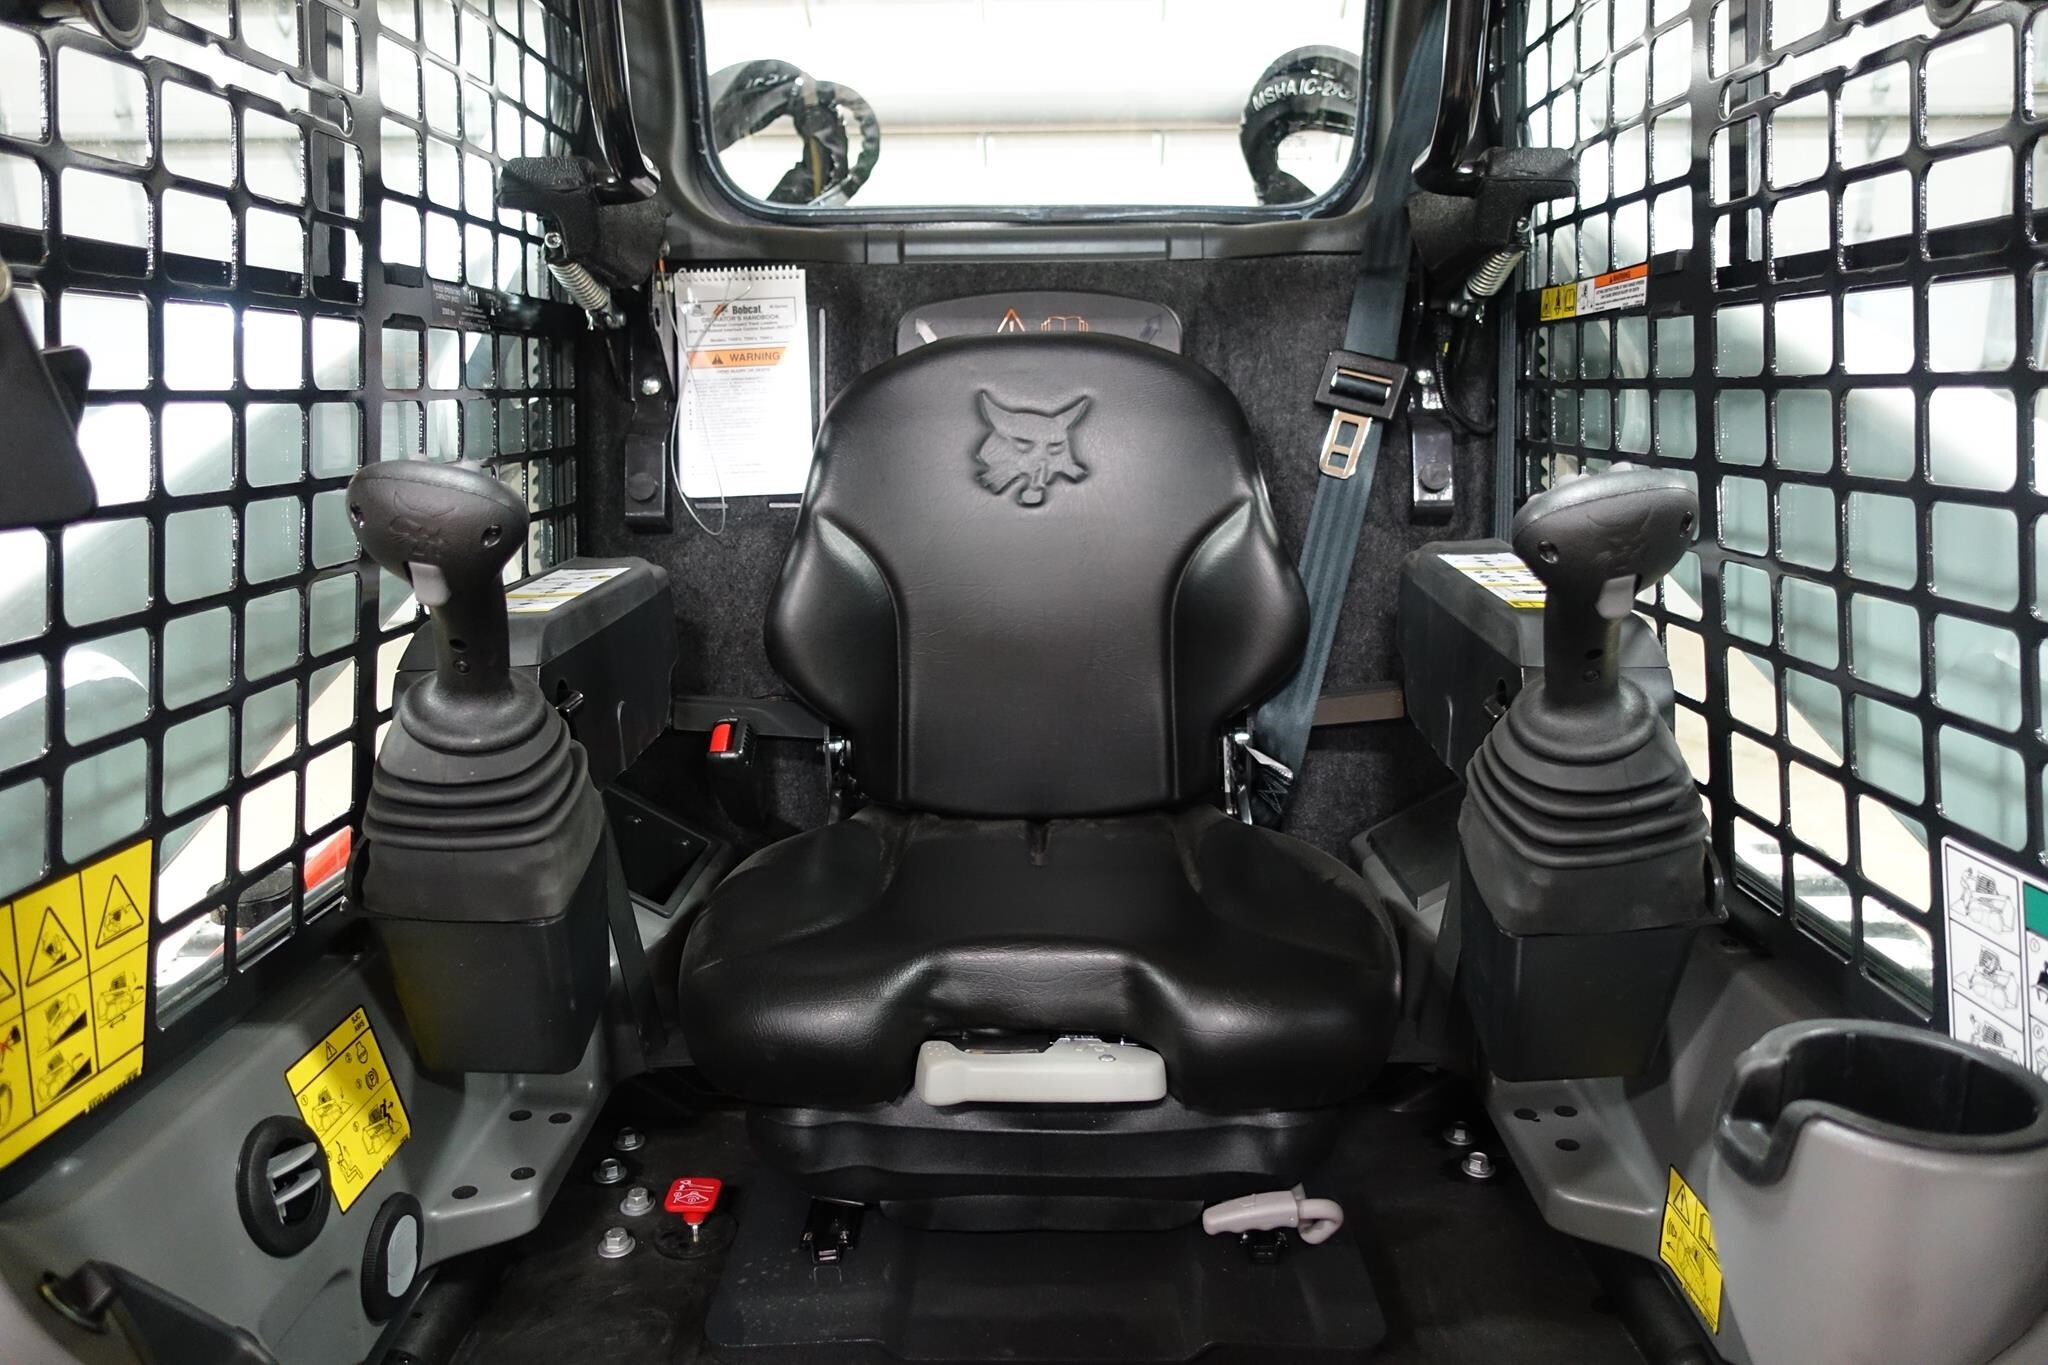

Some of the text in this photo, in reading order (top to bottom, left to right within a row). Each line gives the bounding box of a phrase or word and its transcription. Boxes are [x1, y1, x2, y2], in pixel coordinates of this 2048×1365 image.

[1252, 79, 1298, 111] MSHA
[732, 305, 761, 315] Bobcat
[729, 351, 780, 362] WARNING
